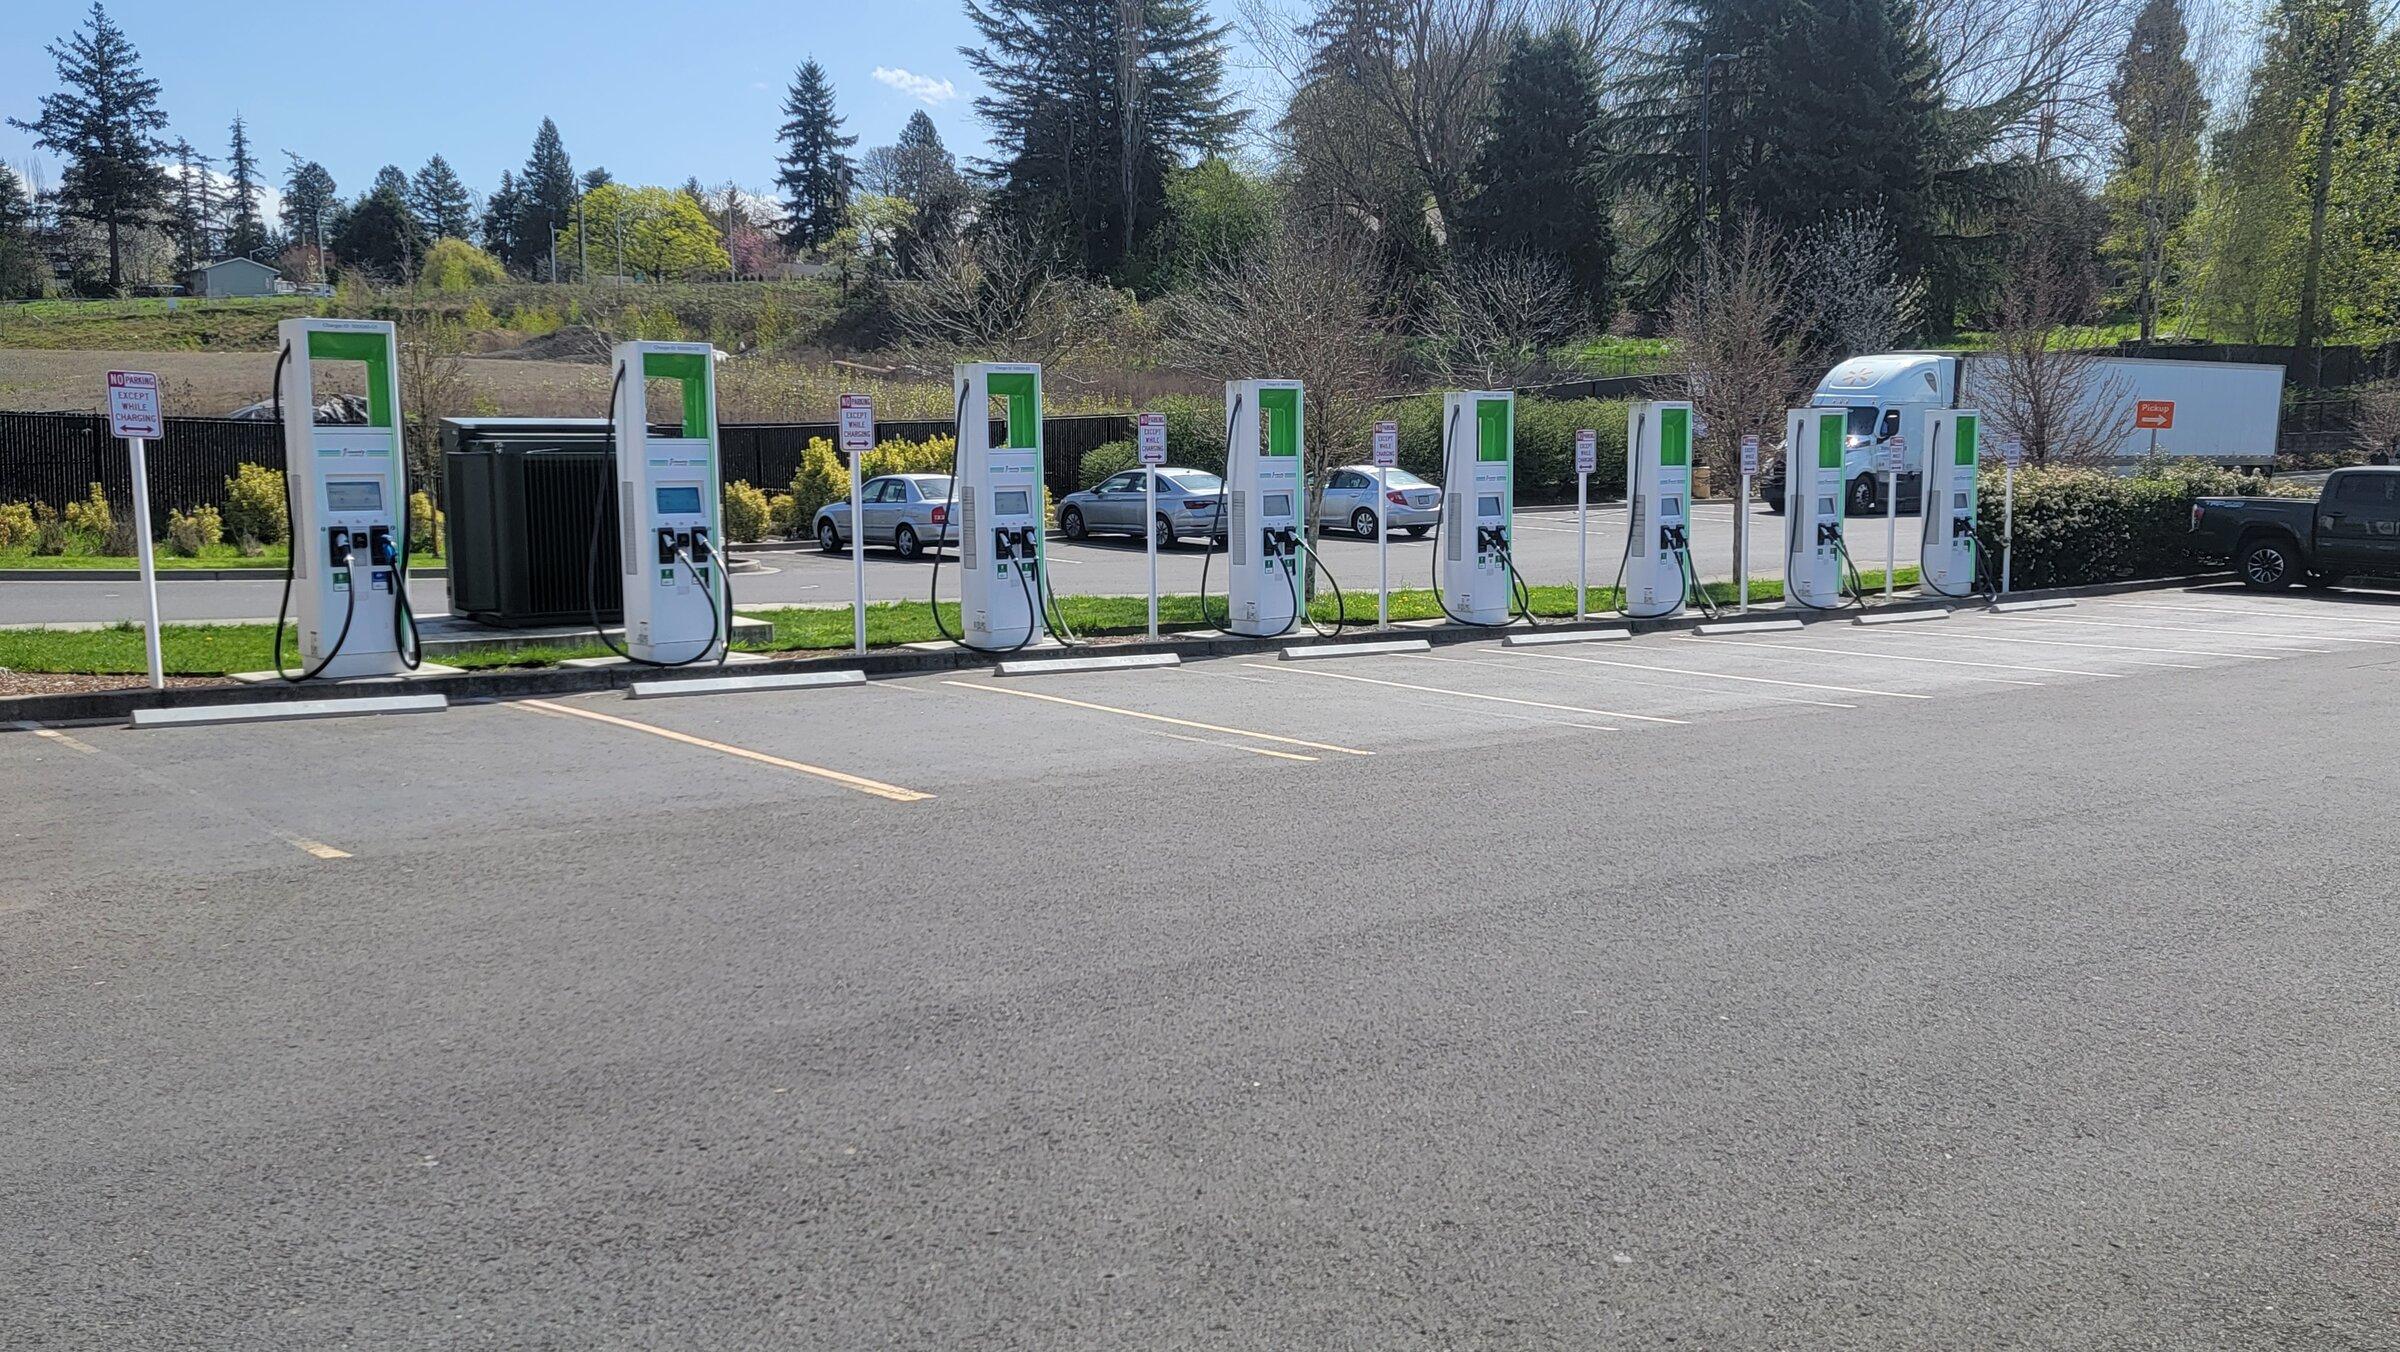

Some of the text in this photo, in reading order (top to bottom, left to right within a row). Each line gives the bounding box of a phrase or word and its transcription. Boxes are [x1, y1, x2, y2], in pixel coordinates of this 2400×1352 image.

[110, 373, 154, 385] NO PARKING
[118, 391, 149, 400] EXCEPT
[122, 402, 147, 411] WHILE
[2141, 403, 2170, 413] Pickup
[115, 413, 157, 422] CHARGING
